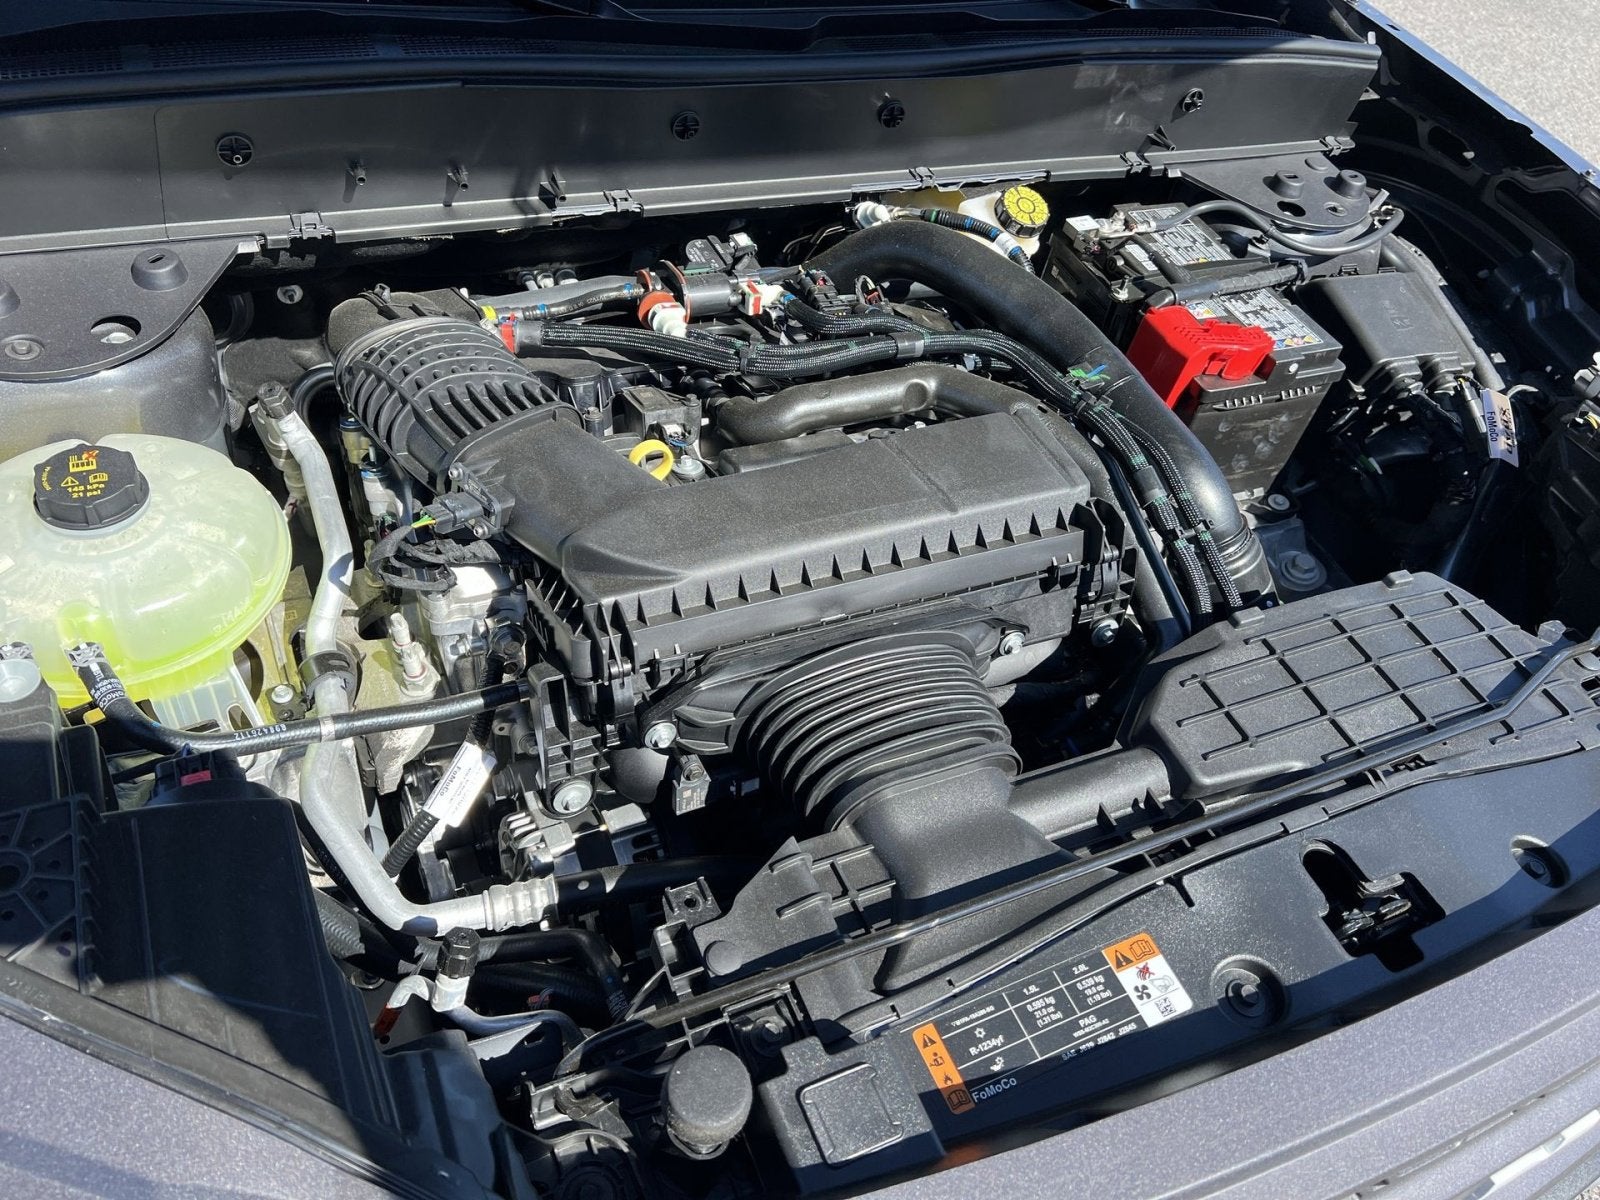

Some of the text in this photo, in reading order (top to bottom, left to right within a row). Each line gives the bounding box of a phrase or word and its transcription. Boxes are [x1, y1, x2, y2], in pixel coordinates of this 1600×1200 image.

[1487, 411, 1499, 442] FoMoCo
[440, 766, 461, 796] FoMoCo
[1079, 1015, 1097, 1027] PAG
[969, 1035, 1004, 1056] R-1234yf
[972, 1077, 1017, 1103] FoMoCo
